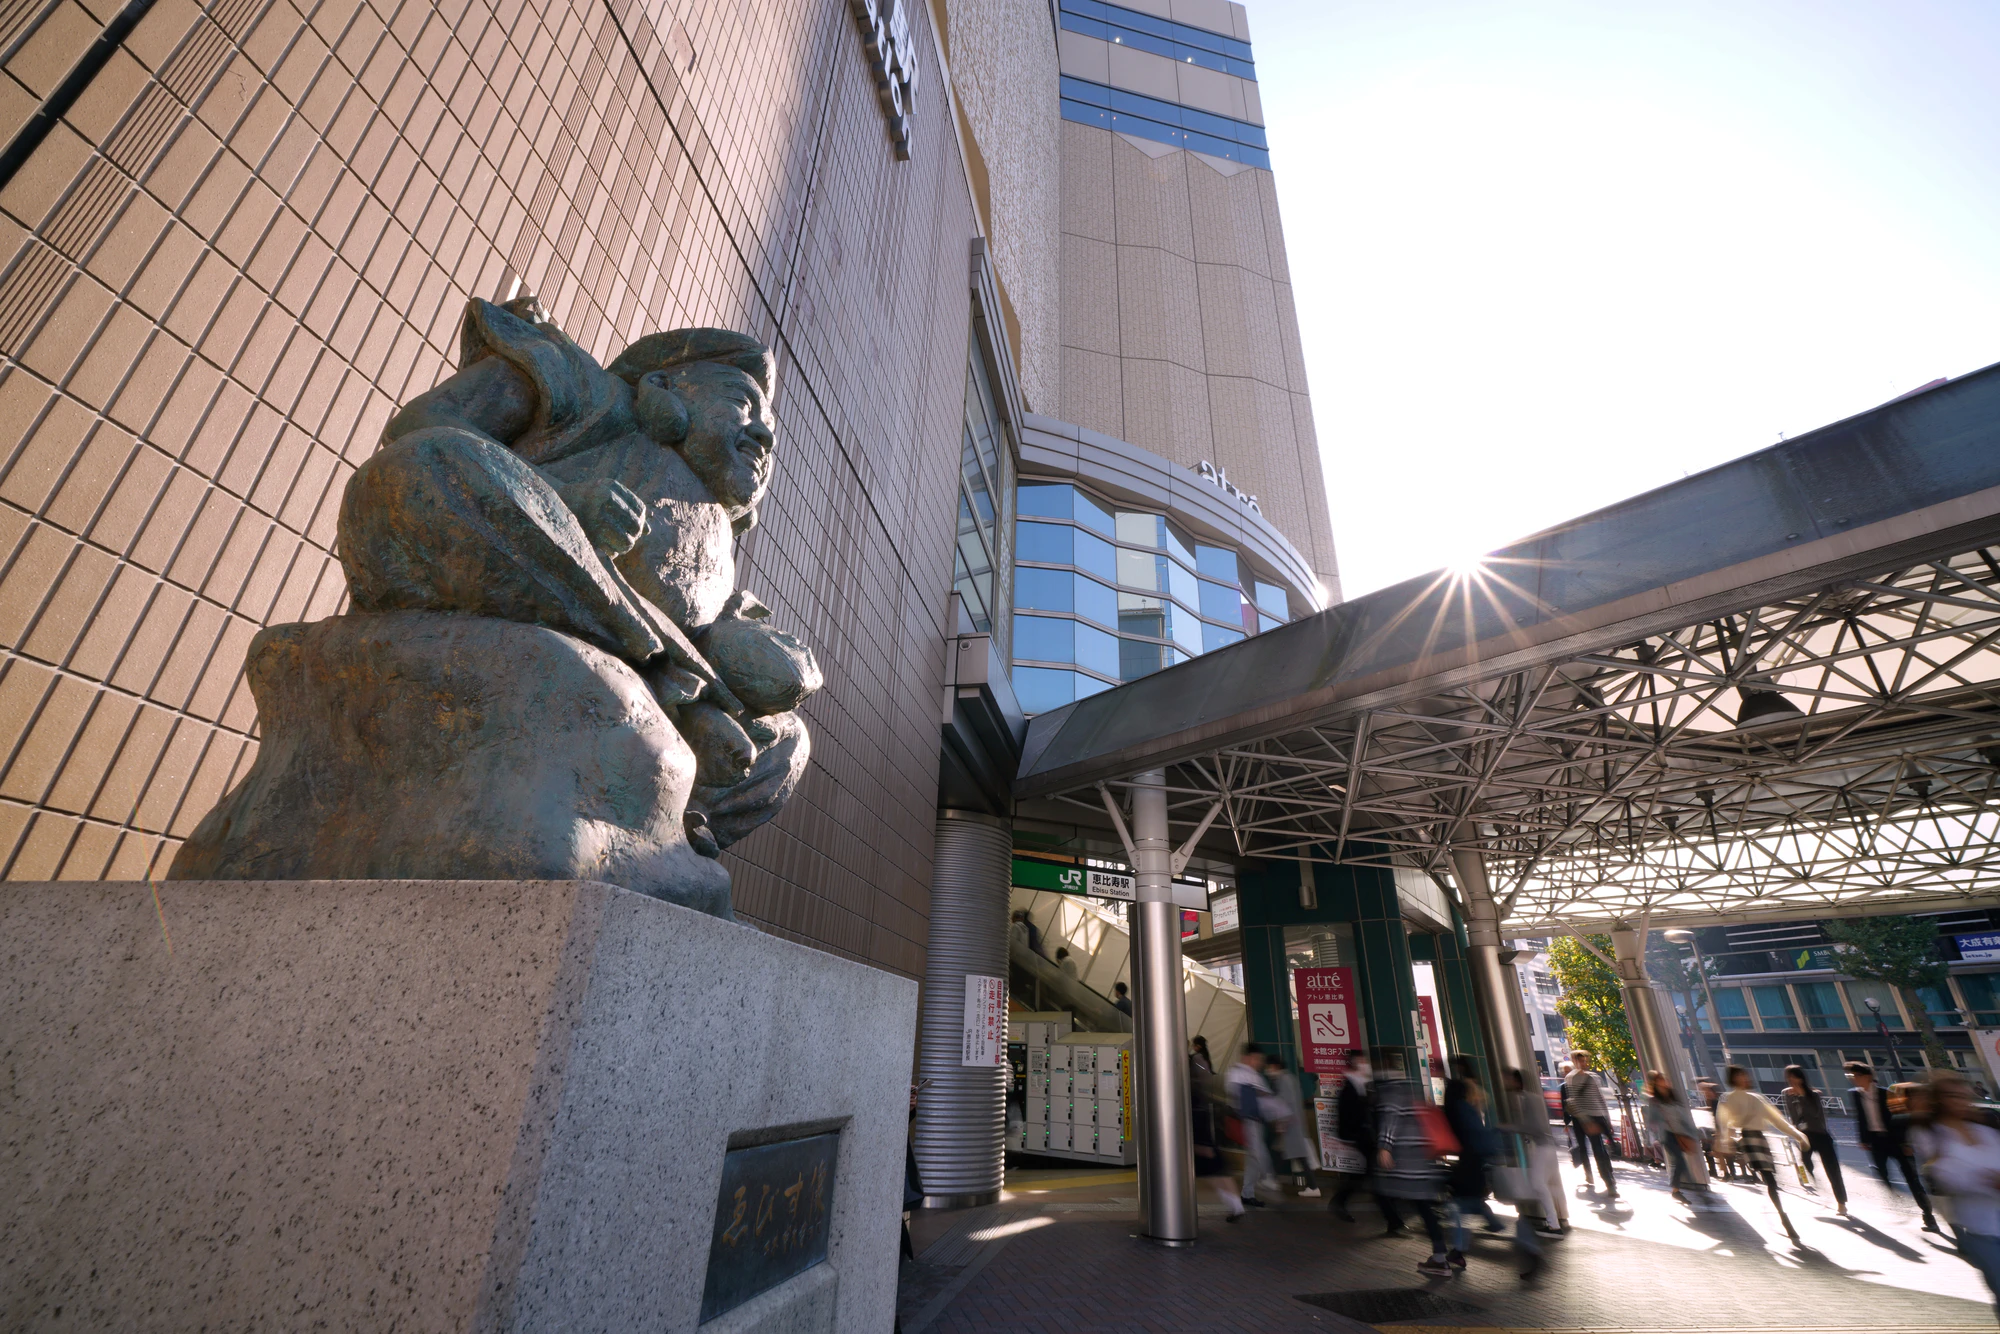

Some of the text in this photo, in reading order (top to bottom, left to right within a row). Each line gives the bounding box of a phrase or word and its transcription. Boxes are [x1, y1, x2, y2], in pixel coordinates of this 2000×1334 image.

[1059, 869, 1082, 886] JR
[1092, 874, 1130, 889] 恵比寿駅
[1092, 886, 1130, 897] Ebisu Station
[1307, 972, 1341, 988] atré
